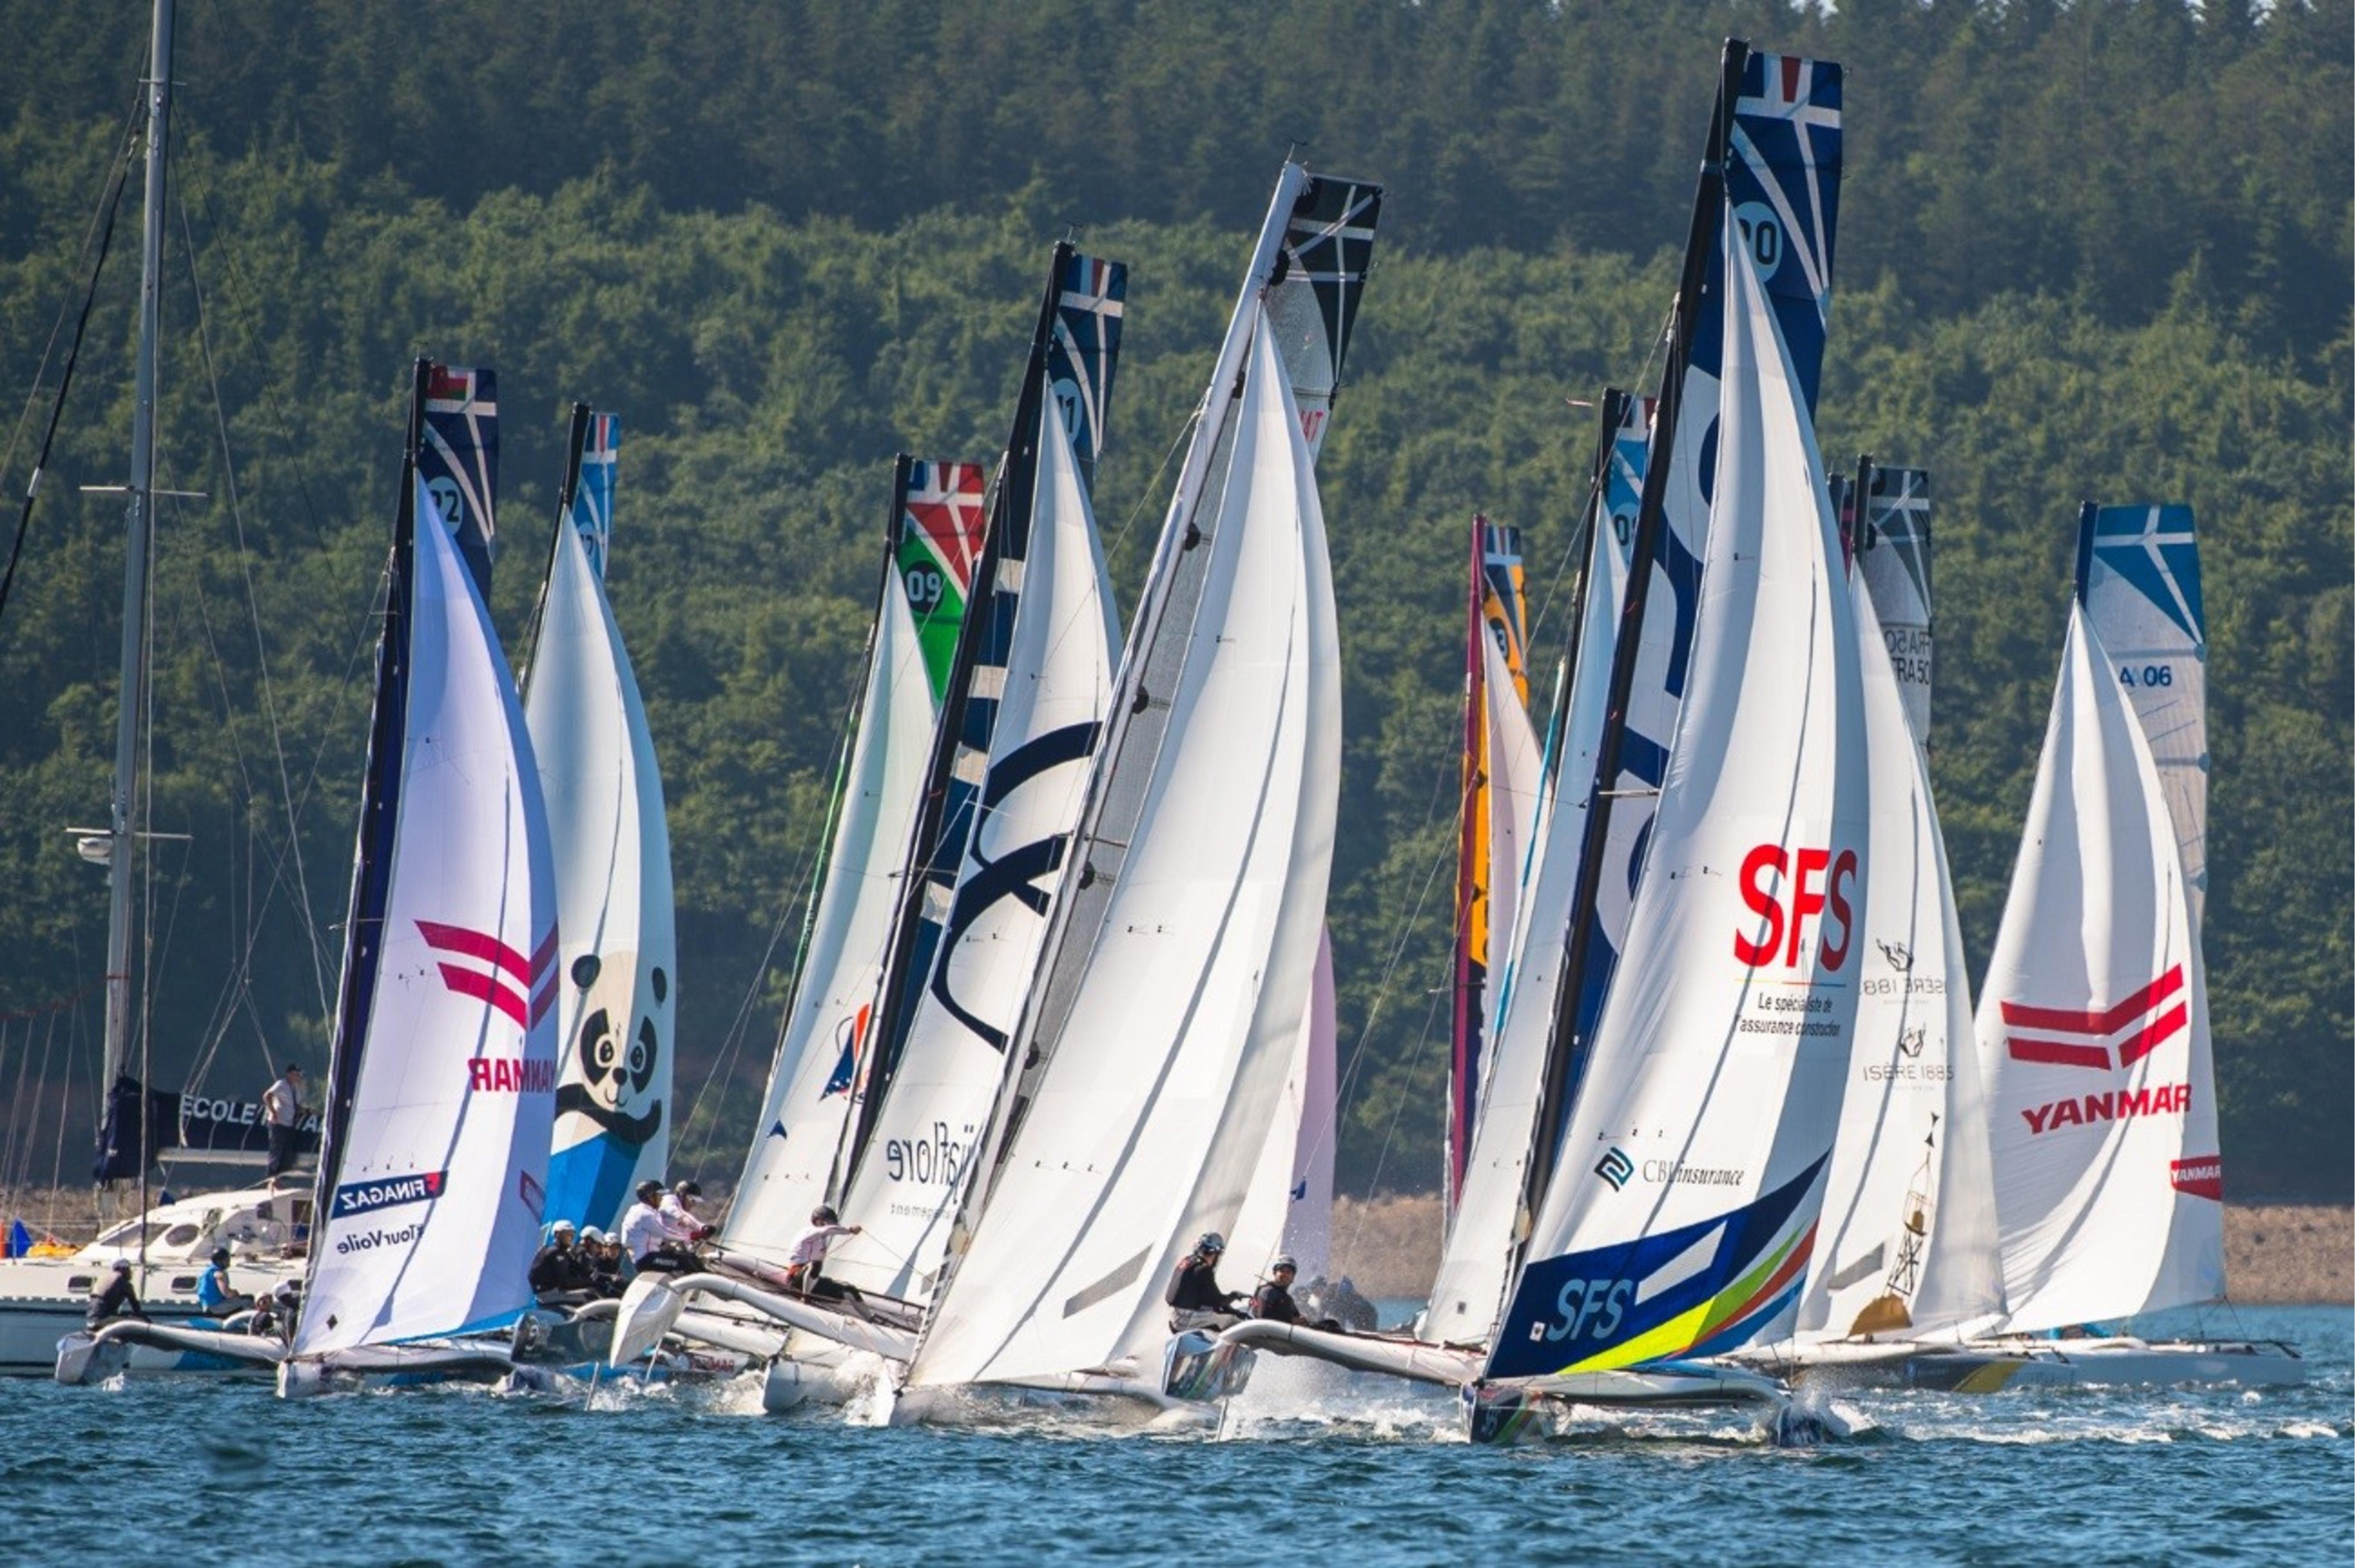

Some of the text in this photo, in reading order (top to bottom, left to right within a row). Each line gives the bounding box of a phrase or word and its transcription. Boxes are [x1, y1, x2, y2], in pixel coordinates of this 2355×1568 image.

[908, 571, 940, 601] 09
[2144, 665, 2172, 687] 06
[1734, 844, 1858, 972] SFS
[1758, 992, 1772, 1011] Le
[1863, 1061, 1916, 1081] ISÈRE
[179, 1094, 257, 1125] ECOLE
[2021, 1084, 2192, 1135] YANMAR
[1546, 1279, 1634, 1342] SFS
